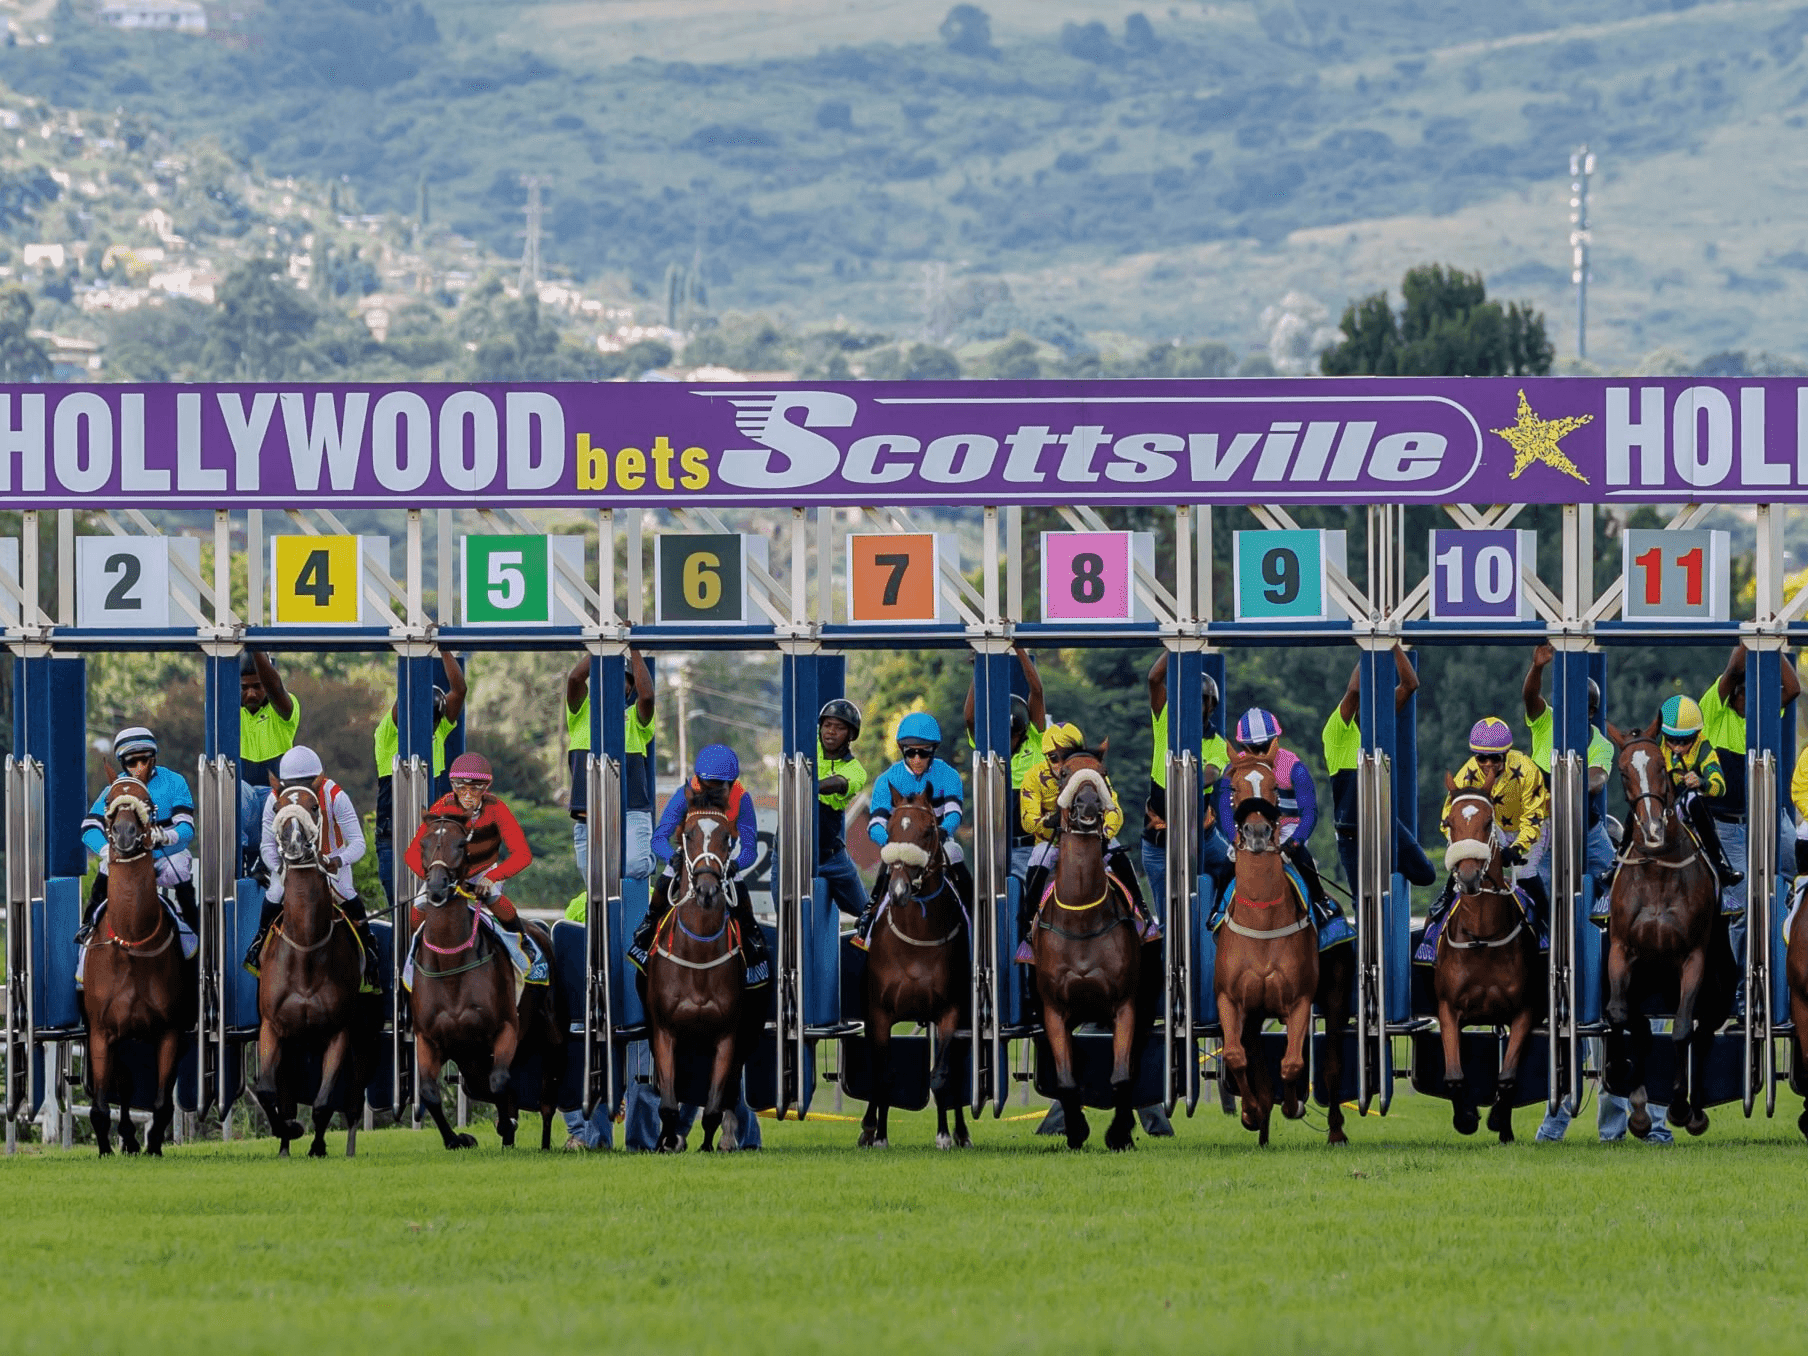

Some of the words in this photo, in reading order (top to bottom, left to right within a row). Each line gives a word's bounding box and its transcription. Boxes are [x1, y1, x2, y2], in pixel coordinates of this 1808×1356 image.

[0, 391, 566, 492] HOLLYWOOD
[576, 433, 710, 491] bets
[705, 391, 1447, 489] Scottsville
[1605, 385, 1808, 487] HOL
[103, 553, 142, 610] 2
[294, 549, 334, 606] 4
[486, 550, 526, 609] 5
[682, 550, 722, 610] 6
[873, 553, 910, 606] 7
[1069, 551, 1106, 604] 8
[1261, 547, 1300, 604] 9
[1435, 545, 1514, 603] 10
[1634, 547, 1703, 605] 11
